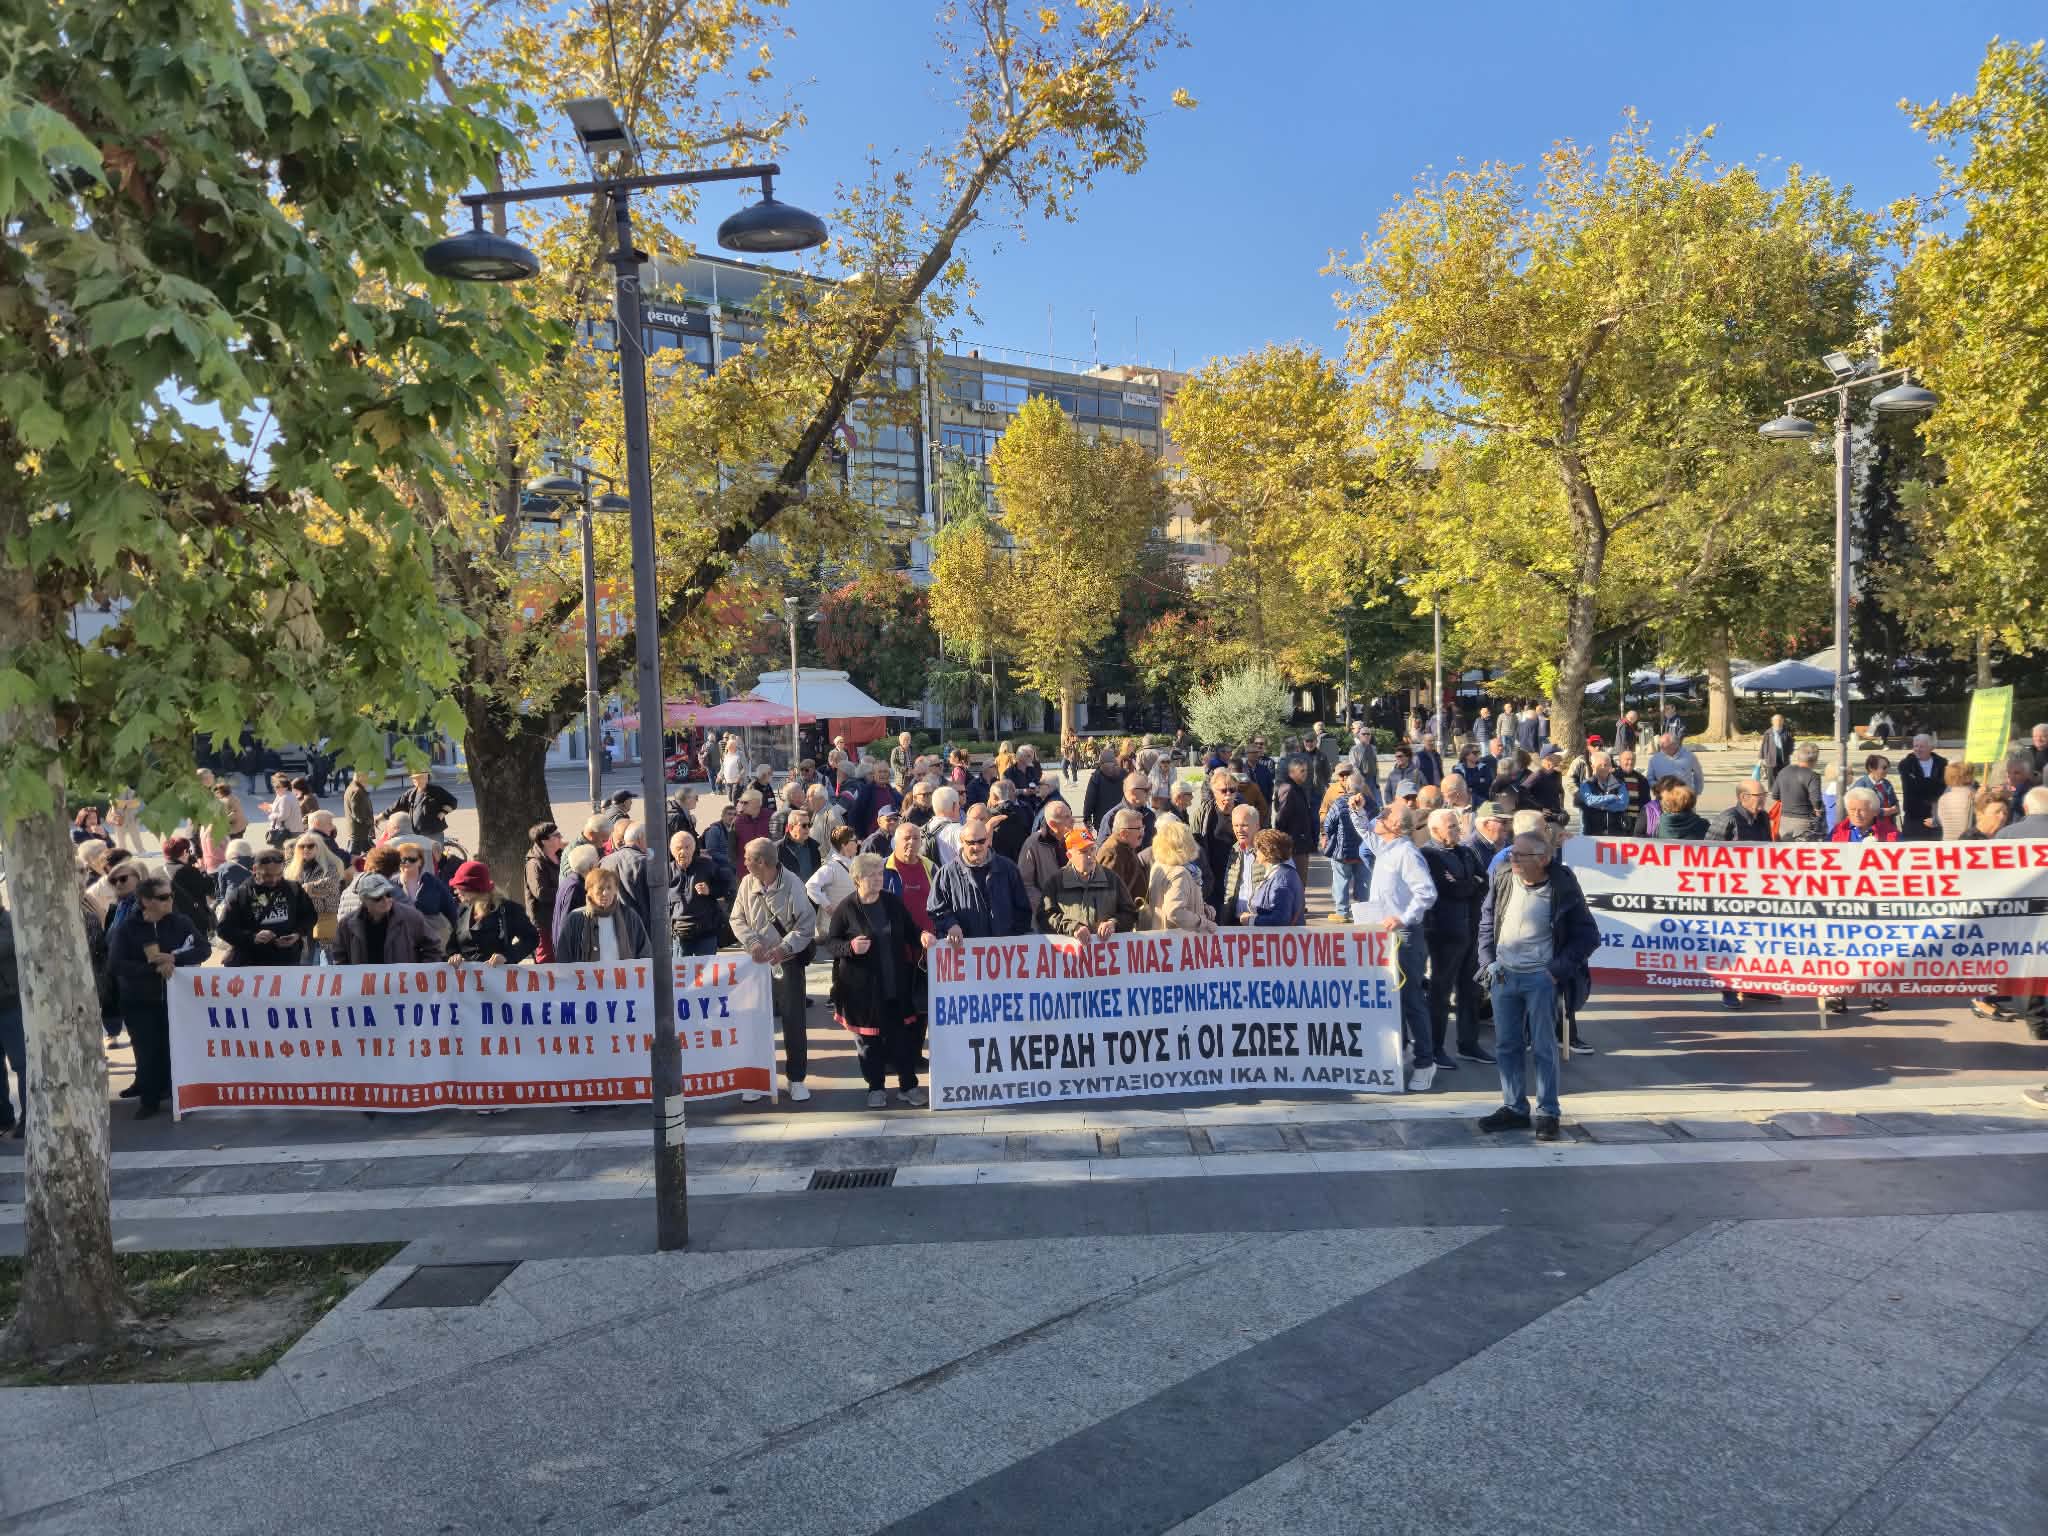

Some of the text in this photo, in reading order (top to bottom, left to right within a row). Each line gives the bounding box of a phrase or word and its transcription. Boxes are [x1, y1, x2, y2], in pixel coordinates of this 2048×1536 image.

[1595, 842, 2048, 870] ΠΡΑΓΜΑΤΙΚΕΣ ΑΥΞΗΣΕΙΣ
[1677, 871, 1961, 897] ΣΤΙΣ ΣΥΝΤΑΞΕΙΣ
[1612, 895, 2029, 916] ΟΧΙ ΣΤΗΝ ΚΟΡΟΙΔΙΑ ΤΩΝ ΕΠΙΔΟΜΑΤΩΝ
[1599, 933, 1625, 948] ΗΣ
[1632, 935, 1746, 954] ΔΗΜΟΣΙΑΣ
[1660, 919, 1984, 940] ΟΥΣΙΑΣΤΙΚΗ ΠΡΟΣΤΑΣΙΑ
[936, 931, 1390, 983] ΜΕ ΤΟΥΣ ΑΓΩΝΕΣ ΜΑΣ ΑΝΑΤΡΕΠΟΥΜΕ ΤΙΣ
[1636, 952, 2009, 977] ΕΞΩ Η ΕΛΛΑΔΑ ΑΠΟ ΤΟΝ ΠΟΛΕΜΟ
[193, 962, 738, 998] ΛΕΦΤΑ ΓΙΑ ΜΙΣΘΟΥΣ ΚΑΙ ΣΥΝΤΞΕΙΣ
[1646, 973, 1998, 997] Σωματείο Συνταξιούχων ΙΚΑ Ελασσόνας
[208, 996, 730, 1029] ΚΑΙ ΟΧΙ ΓΙΑ ΤΟΥΣ ΠΟΛΕΜΟΥΣ ΟΥΣ
[935, 991, 1024, 1025] ΒΑΡΒΑΡΕΣ
[1030, 988, 1122, 1021] ΠΟΛΙΤΙΚΕΣ
[207, 1027, 738, 1058] ΕΠΑΝΑΦΟΡΑ ΤΗΣ 13ΗΣ ΚΑΙ 14ΗΣ ΣΥΝΑΞΗΣ
[969, 1022, 1363, 1073] ΤΑ ΚΕΡΔΗ ΤΟΥΣ ή ΟΙ ΖΩΕΣ ΜΑΣ
[942, 1066, 1394, 1102] ΣΩΜΑΤΕΙΟ ΣΥΝΤΑΞΙΟΥΧΩΝ ΙΚΑ Ν. ΛΑΡΙΣΑΣ
